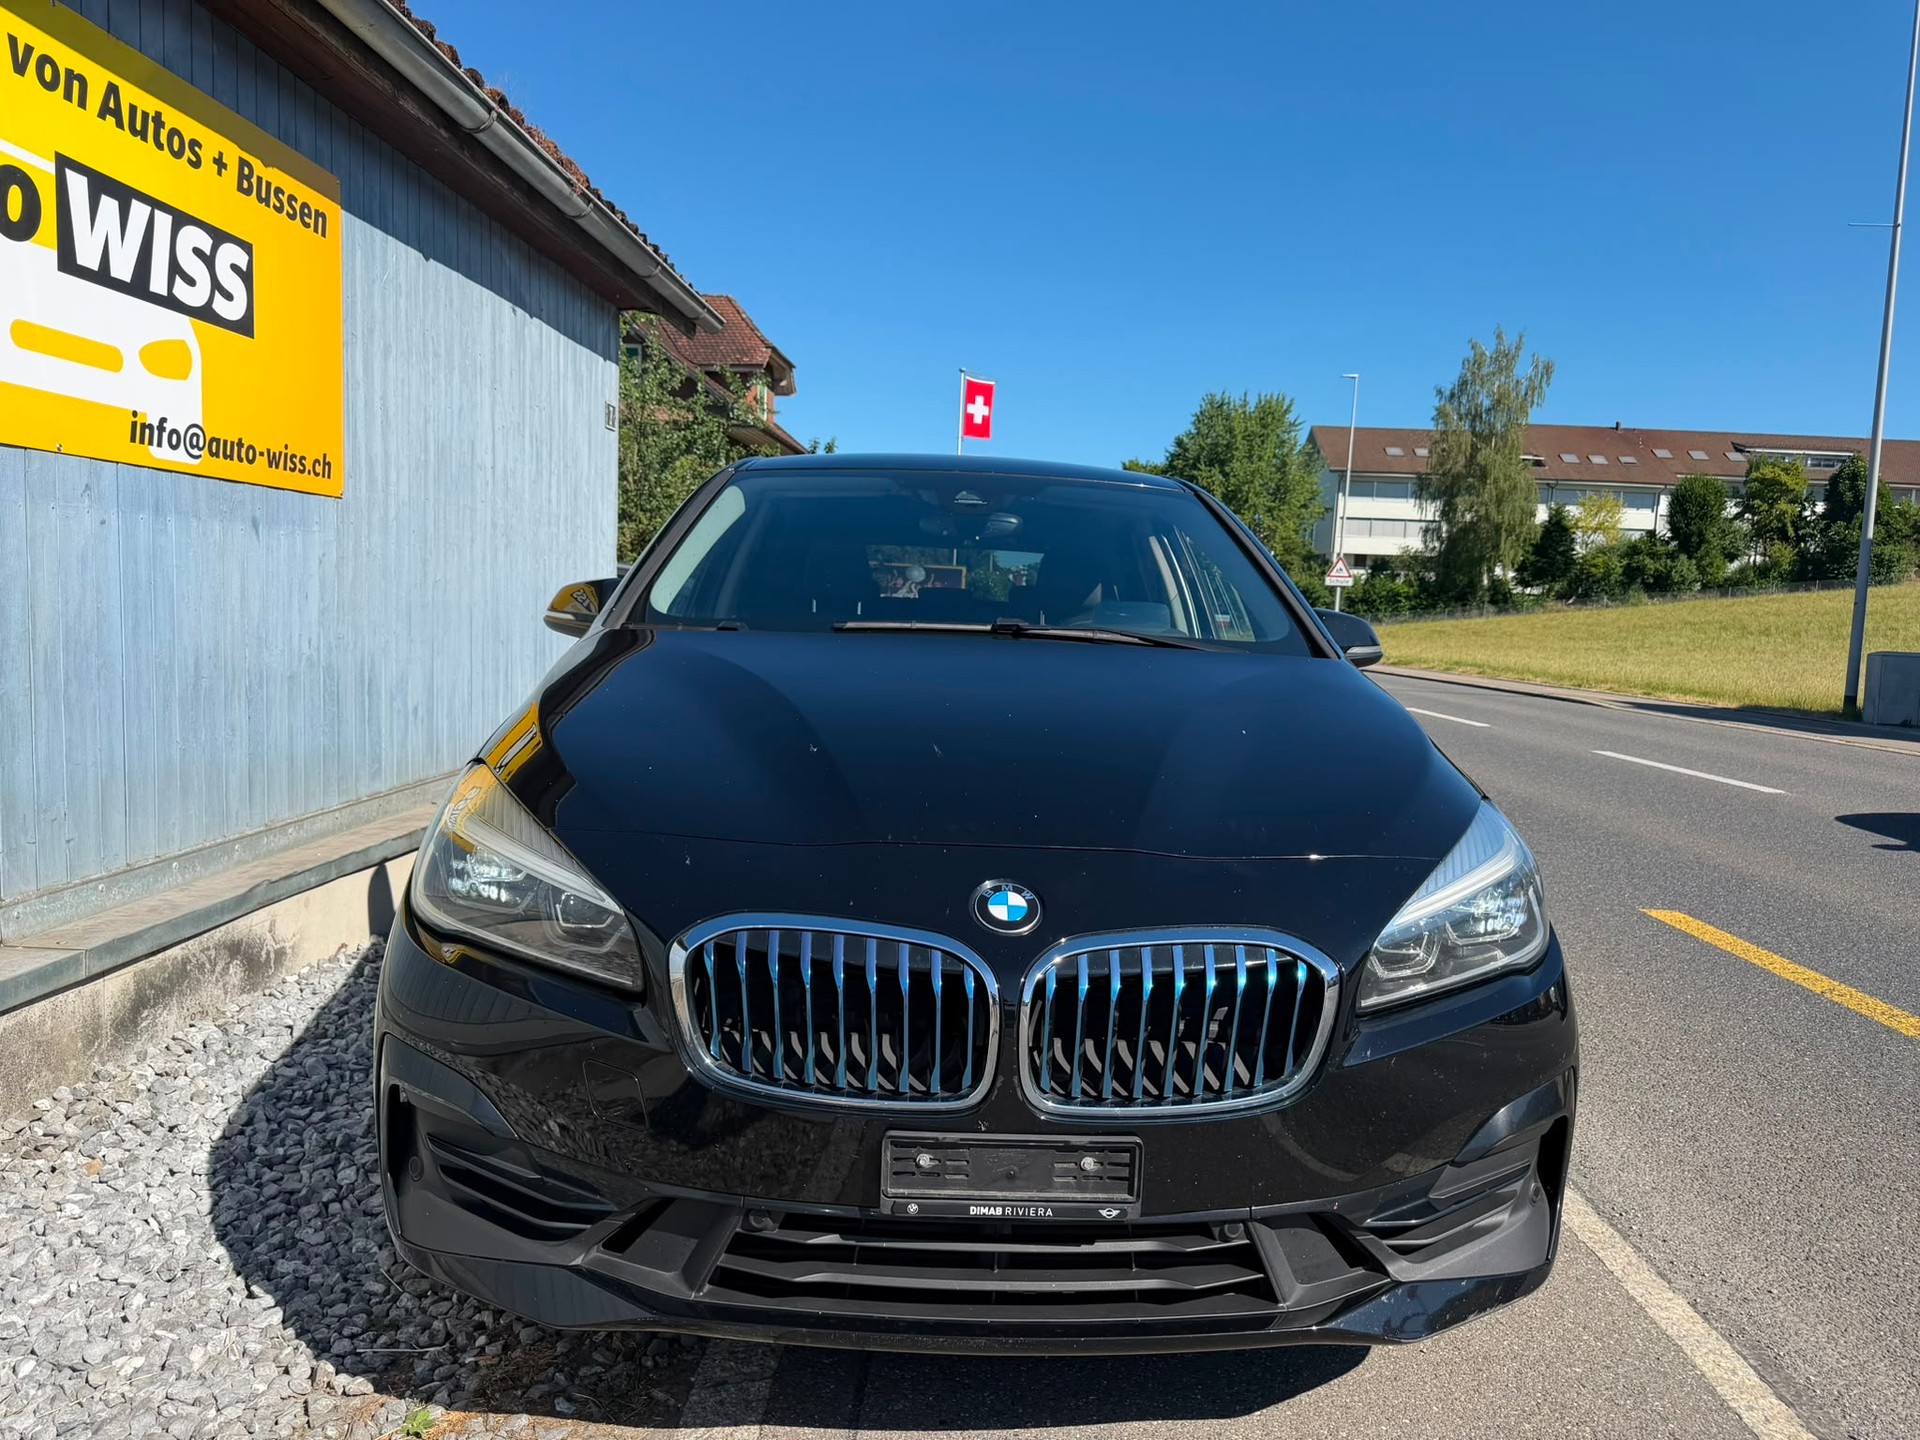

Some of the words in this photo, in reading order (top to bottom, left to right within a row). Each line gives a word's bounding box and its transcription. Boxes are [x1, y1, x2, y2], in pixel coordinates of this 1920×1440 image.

[7, 32, 88, 111] von
[97, 80, 203, 170] Autos
[213, 151, 228, 177] +
[237, 156, 328, 238] Bussen
[65, 168, 250, 321] WISS
[130, 410, 332, 479] info@auto-wiss.ch
[982, 884, 1034, 900] BMW
[970, 1206, 1003, 1216] DIMAB
[1005, 1207, 1053, 1217] RIVIERA
